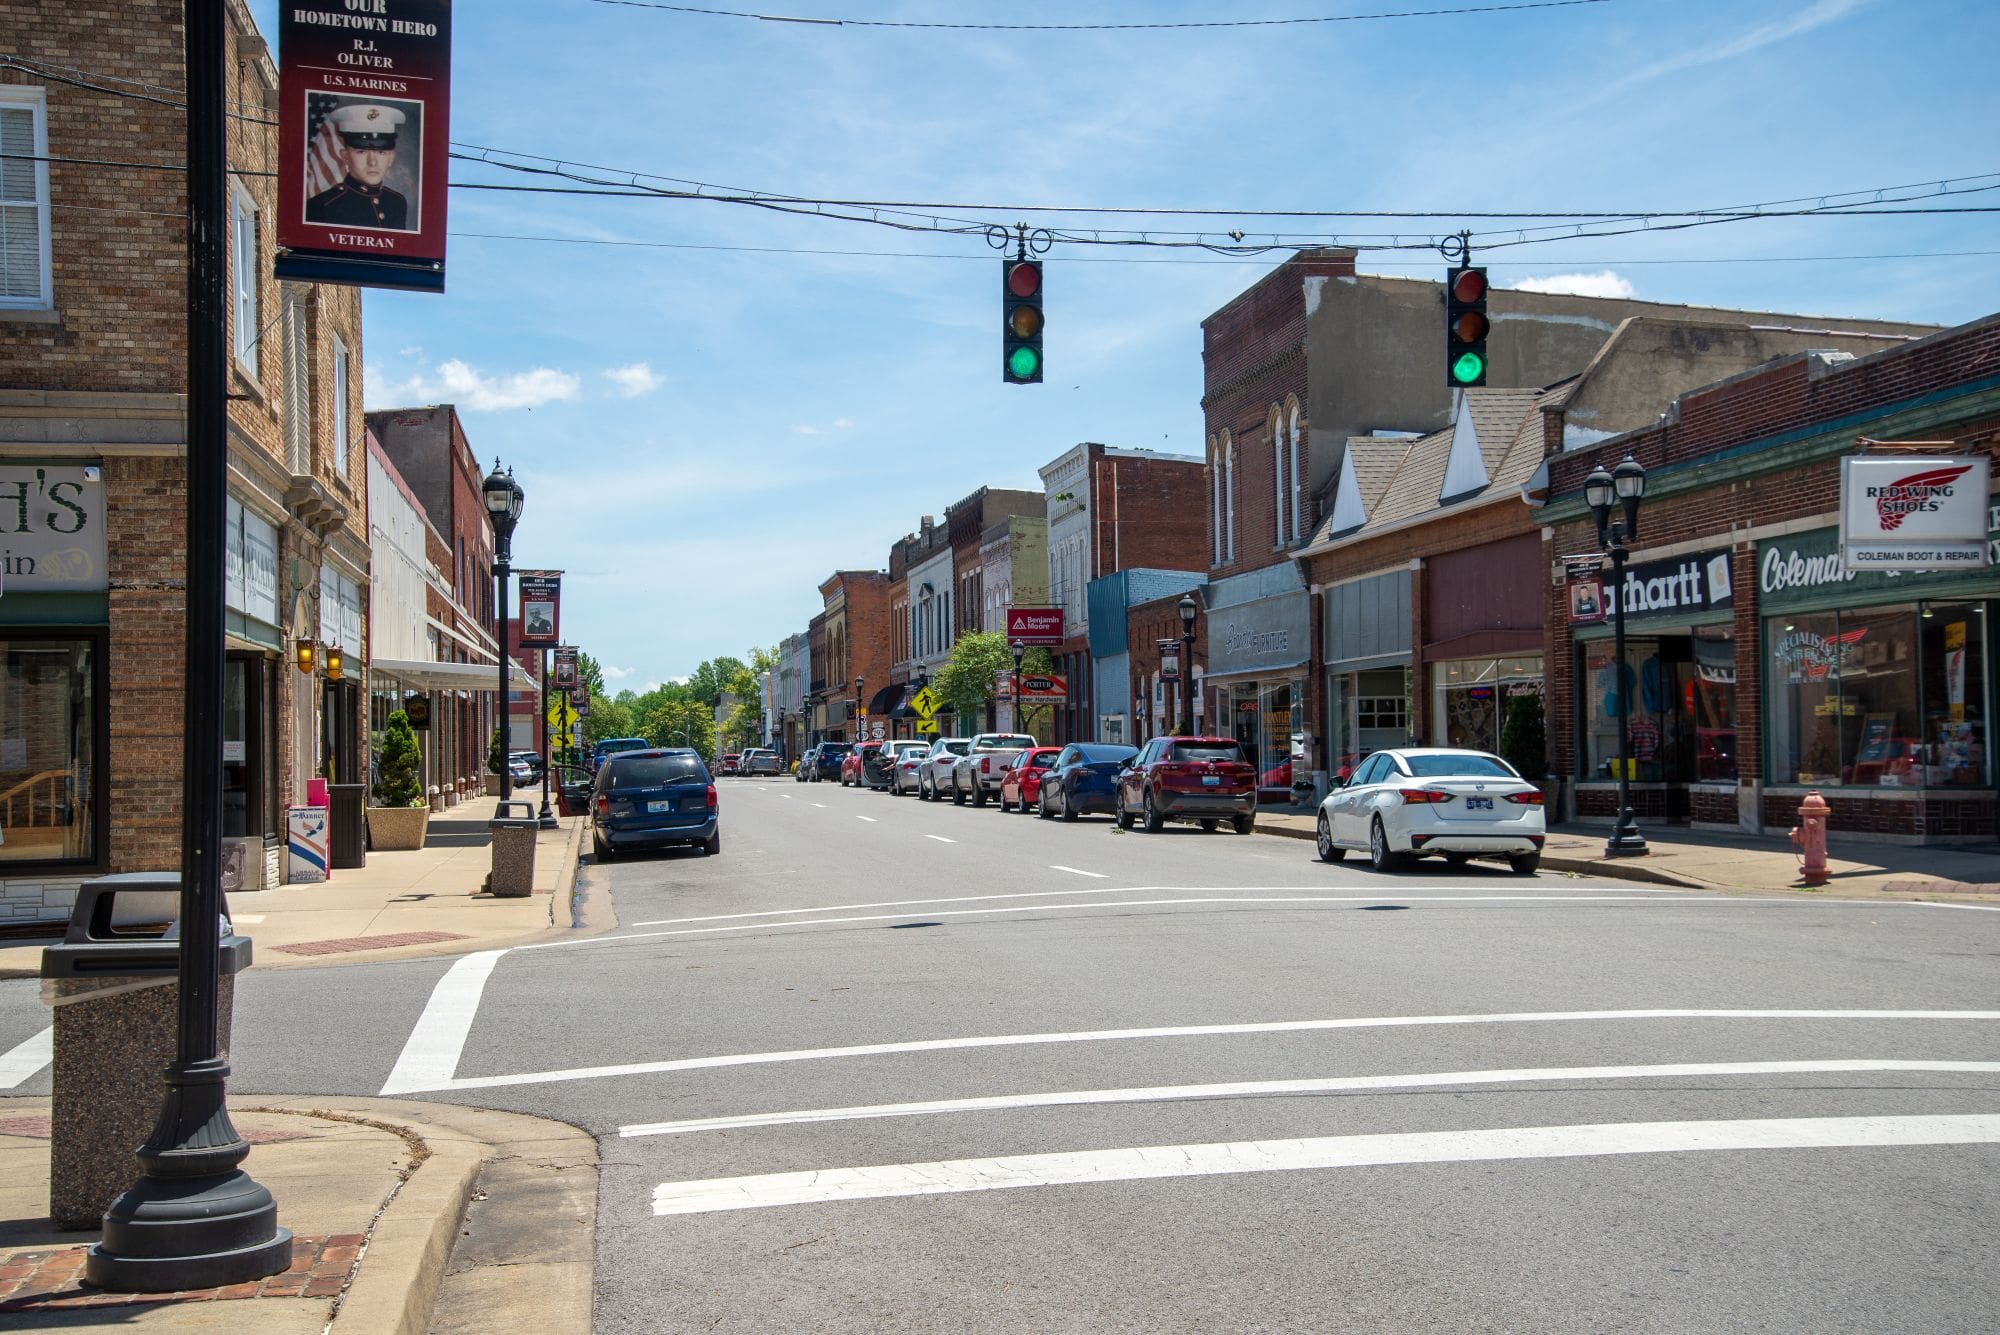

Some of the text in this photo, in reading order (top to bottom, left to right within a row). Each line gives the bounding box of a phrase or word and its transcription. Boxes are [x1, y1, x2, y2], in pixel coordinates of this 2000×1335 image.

[345, 0, 387, 13] OUR
[294, 9, 438, 37] HOMETOWN HERO
[353, 39, 378, 52] R.J.
[337, 53, 394, 69] OLIVER
[323, 74, 407, 92] U.S. MARINES
[328, 233, 395, 249] VETERAN
[1866, 485, 1954, 498] RED WING
[1882, 500, 1939, 513] SHOES
[1857, 551, 1980, 561] COLEMAN BOOT & REPAIR
[1603, 561, 1703, 616] arhartt
[1027, 616, 1060, 624] Benjamin
[298, 811, 325, 820] Banner
